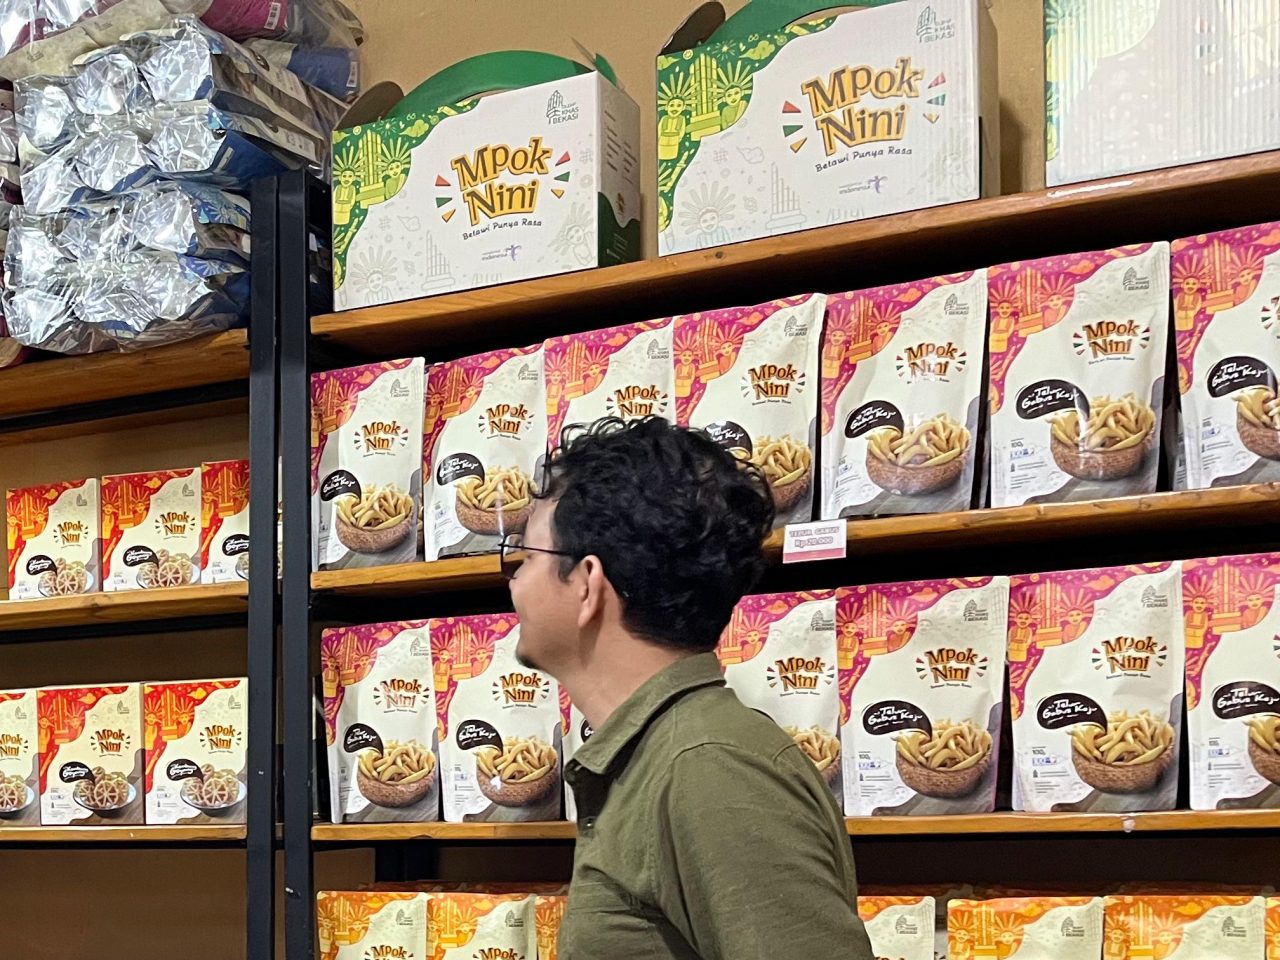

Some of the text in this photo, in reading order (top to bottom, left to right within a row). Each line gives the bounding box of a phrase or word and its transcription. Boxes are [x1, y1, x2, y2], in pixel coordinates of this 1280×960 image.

[801, 58, 923, 117] Mpok
[553, 114, 579, 125] BEKASI
[816, 104, 907, 155] Nini
[451, 137, 552, 191] Mpok
[815, 146, 913, 173] Betawi Punya Rasa
[463, 179, 540, 226] Nini
[463, 218, 542, 240] Betawi Punya Rasa
[1082, 318, 1141, 340] Mpok
[904, 341, 958, 362] Mpok
[1089, 336, 1133, 359] Nini
[748, 363, 797, 383] Mpok
[910, 358, 949, 377] Nini
[615, 384, 660, 402] Mpok
[754, 380, 791, 399] Nini
[486, 403, 527, 421] Mpok
[620, 400, 653, 417] Nini
[361, 420, 401, 437] Mpok
[490, 419, 521, 434] Nini
[366, 436, 395, 452] Nini
[160, 511, 190, 524] Mpok
[164, 524, 187, 536] Nini
[1102, 636, 1158, 655] Mpok
[925, 648, 978, 666] Mpok
[1108, 655, 1150, 674] Nini
[775, 657, 826, 676] Mpok
[931, 664, 970, 683] Nini
[380, 679, 422, 694] Mpok
[500, 672, 543, 688] Mpok
[781, 673, 820, 691] Nini
[386, 693, 416, 708] Nini
[503, 687, 535, 703] Nini
[95, 729, 125, 741] Mpok
[205, 725, 236, 737] Mpok
[99, 741, 122, 753] Nini
[209, 738, 233, 750] Nini
[371, 944, 408, 959] Mpok
